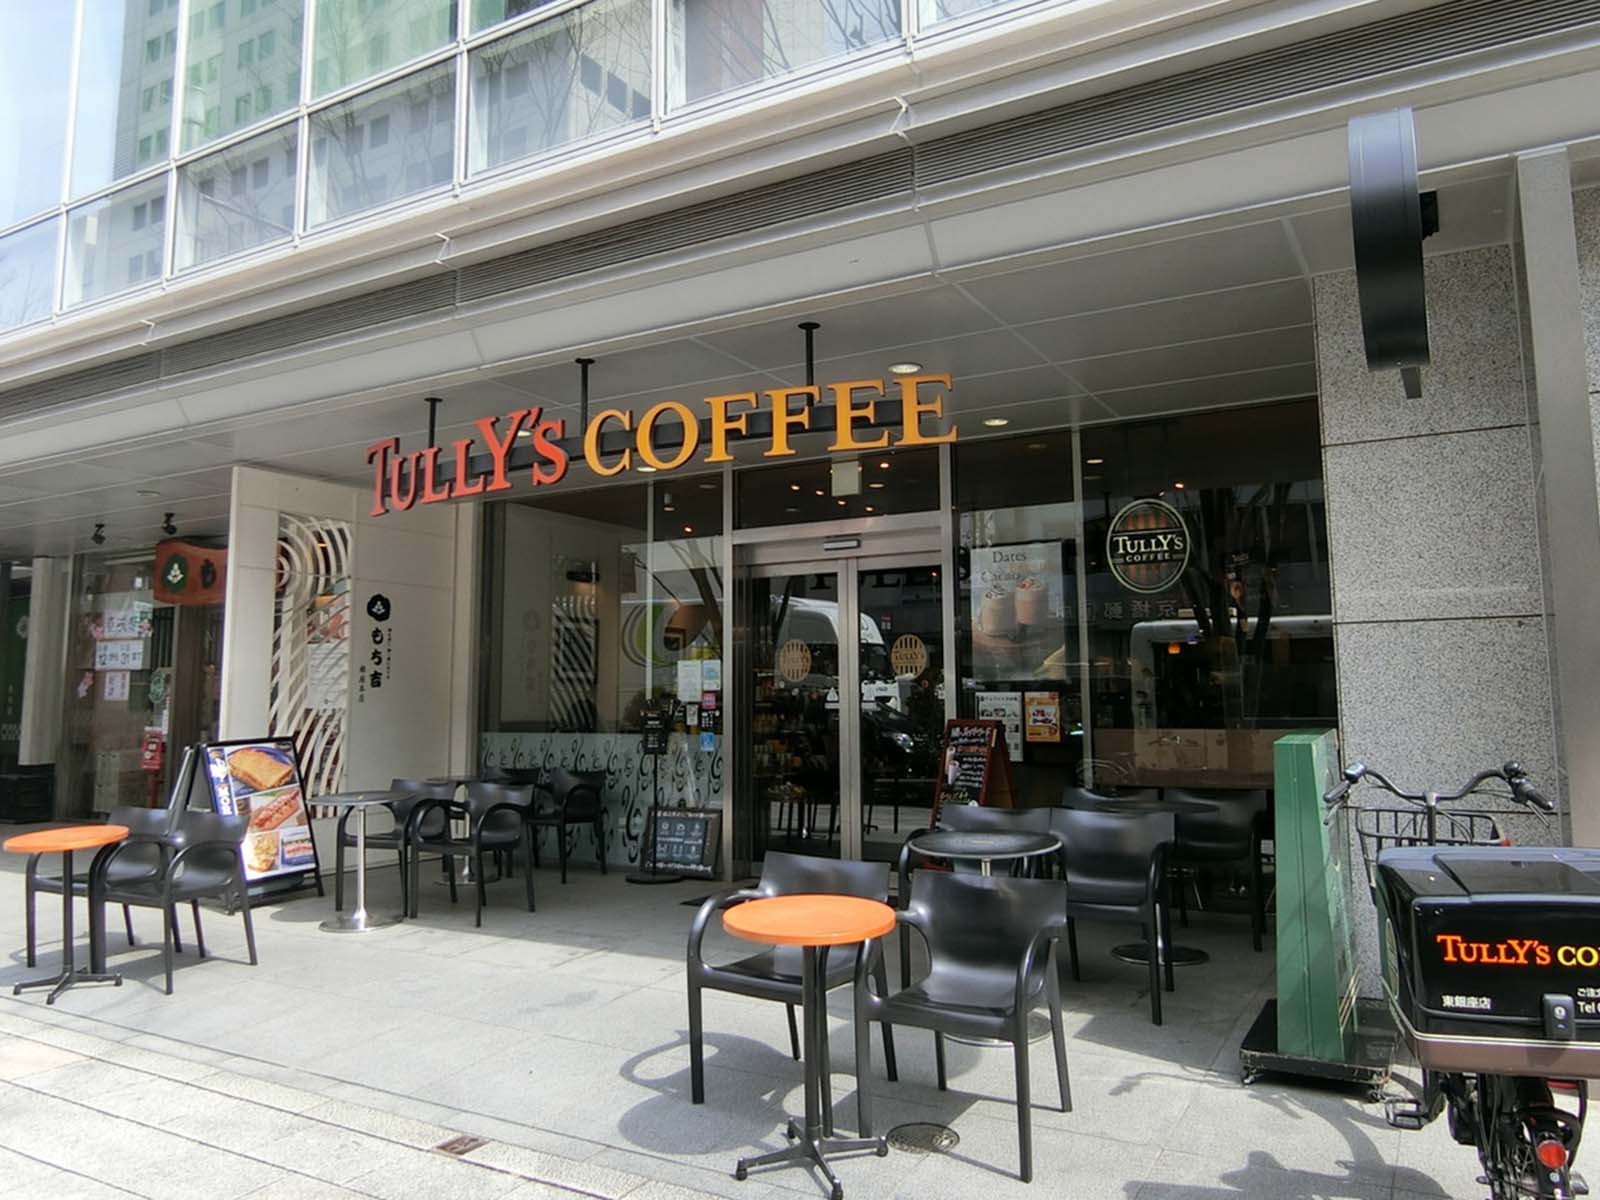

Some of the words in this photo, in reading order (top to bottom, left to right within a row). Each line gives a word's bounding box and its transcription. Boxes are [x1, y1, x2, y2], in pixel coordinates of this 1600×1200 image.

[584, 373, 960, 478] COFFEE
[992, 550, 1027, 564] Dates
[1125, 551, 1171, 563] COFFEE
[369, 626, 384, 688] もち吉
[1556, 945, 1600, 967] CO
[1441, 994, 1491, 1010] 東銀座店
[1577, 1002, 1596, 1014] Tel
